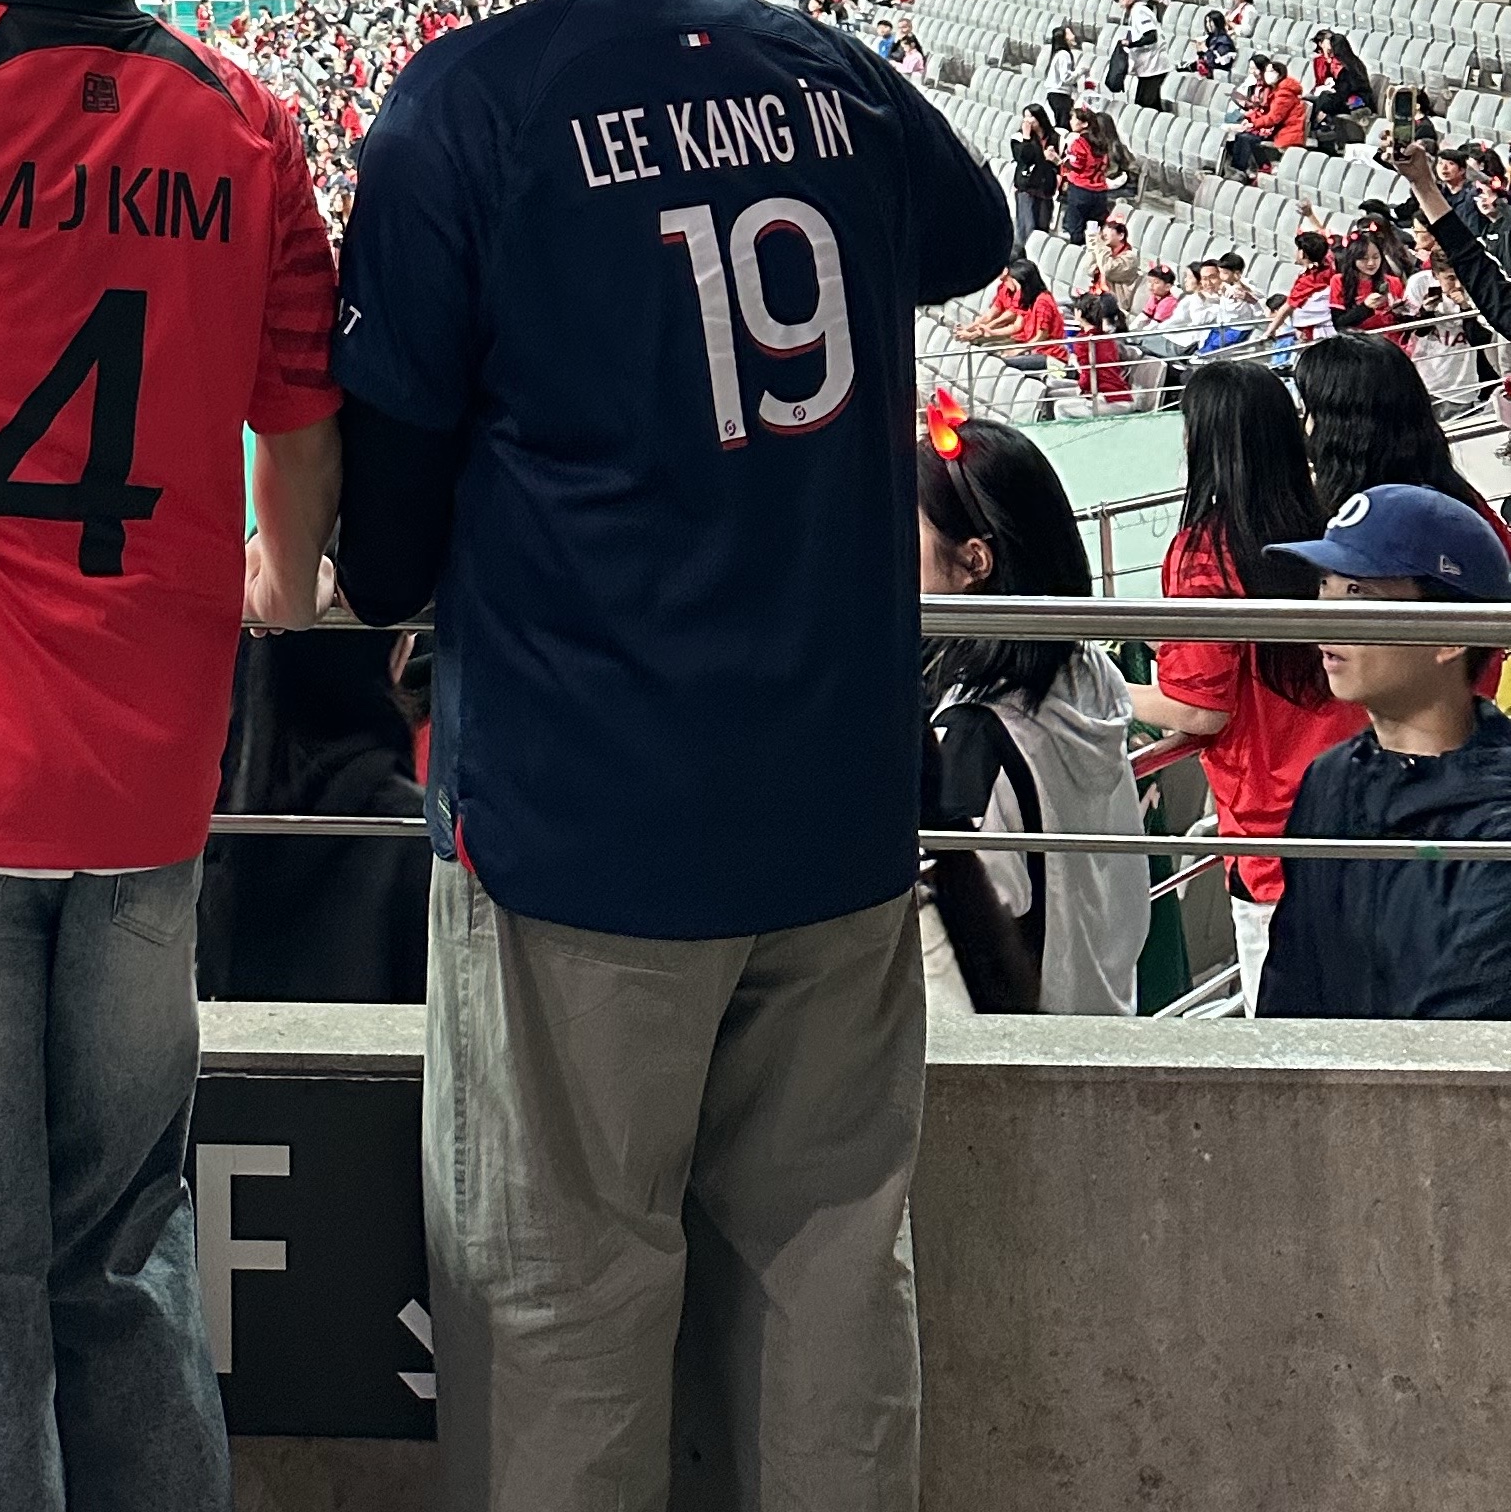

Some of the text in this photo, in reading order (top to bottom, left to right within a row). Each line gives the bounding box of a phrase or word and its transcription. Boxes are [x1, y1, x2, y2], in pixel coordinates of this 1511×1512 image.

[58, 165, 88, 232] J
[108, 165, 234, 244] KIM
[571, 108, 661, 188] LEE
[666, 94, 795, 172] KANG
[659, 197, 856, 451] 19
[195, 1143, 291, 1374] F
